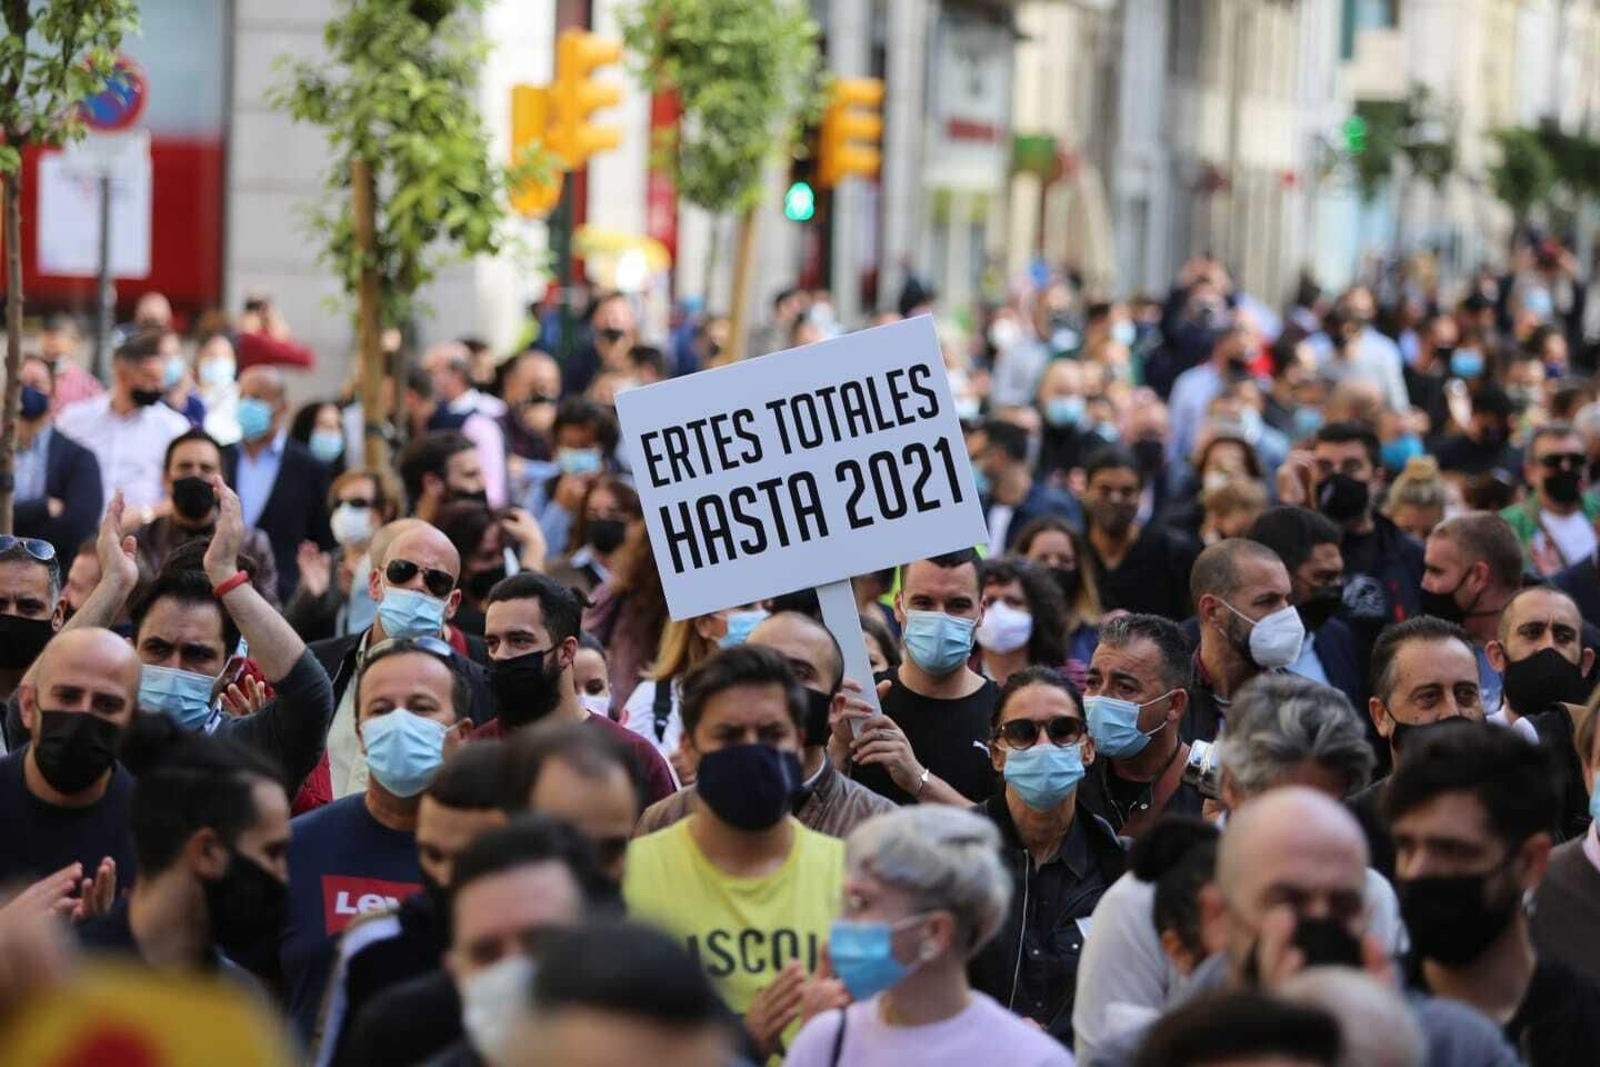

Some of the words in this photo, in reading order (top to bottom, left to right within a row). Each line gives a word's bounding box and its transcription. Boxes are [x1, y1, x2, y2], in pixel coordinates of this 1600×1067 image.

[641, 408, 764, 488] ERTES
[766, 363, 940, 455] TOTALES
[659, 470, 830, 573] HASTA
[835, 436, 963, 530] 2021
